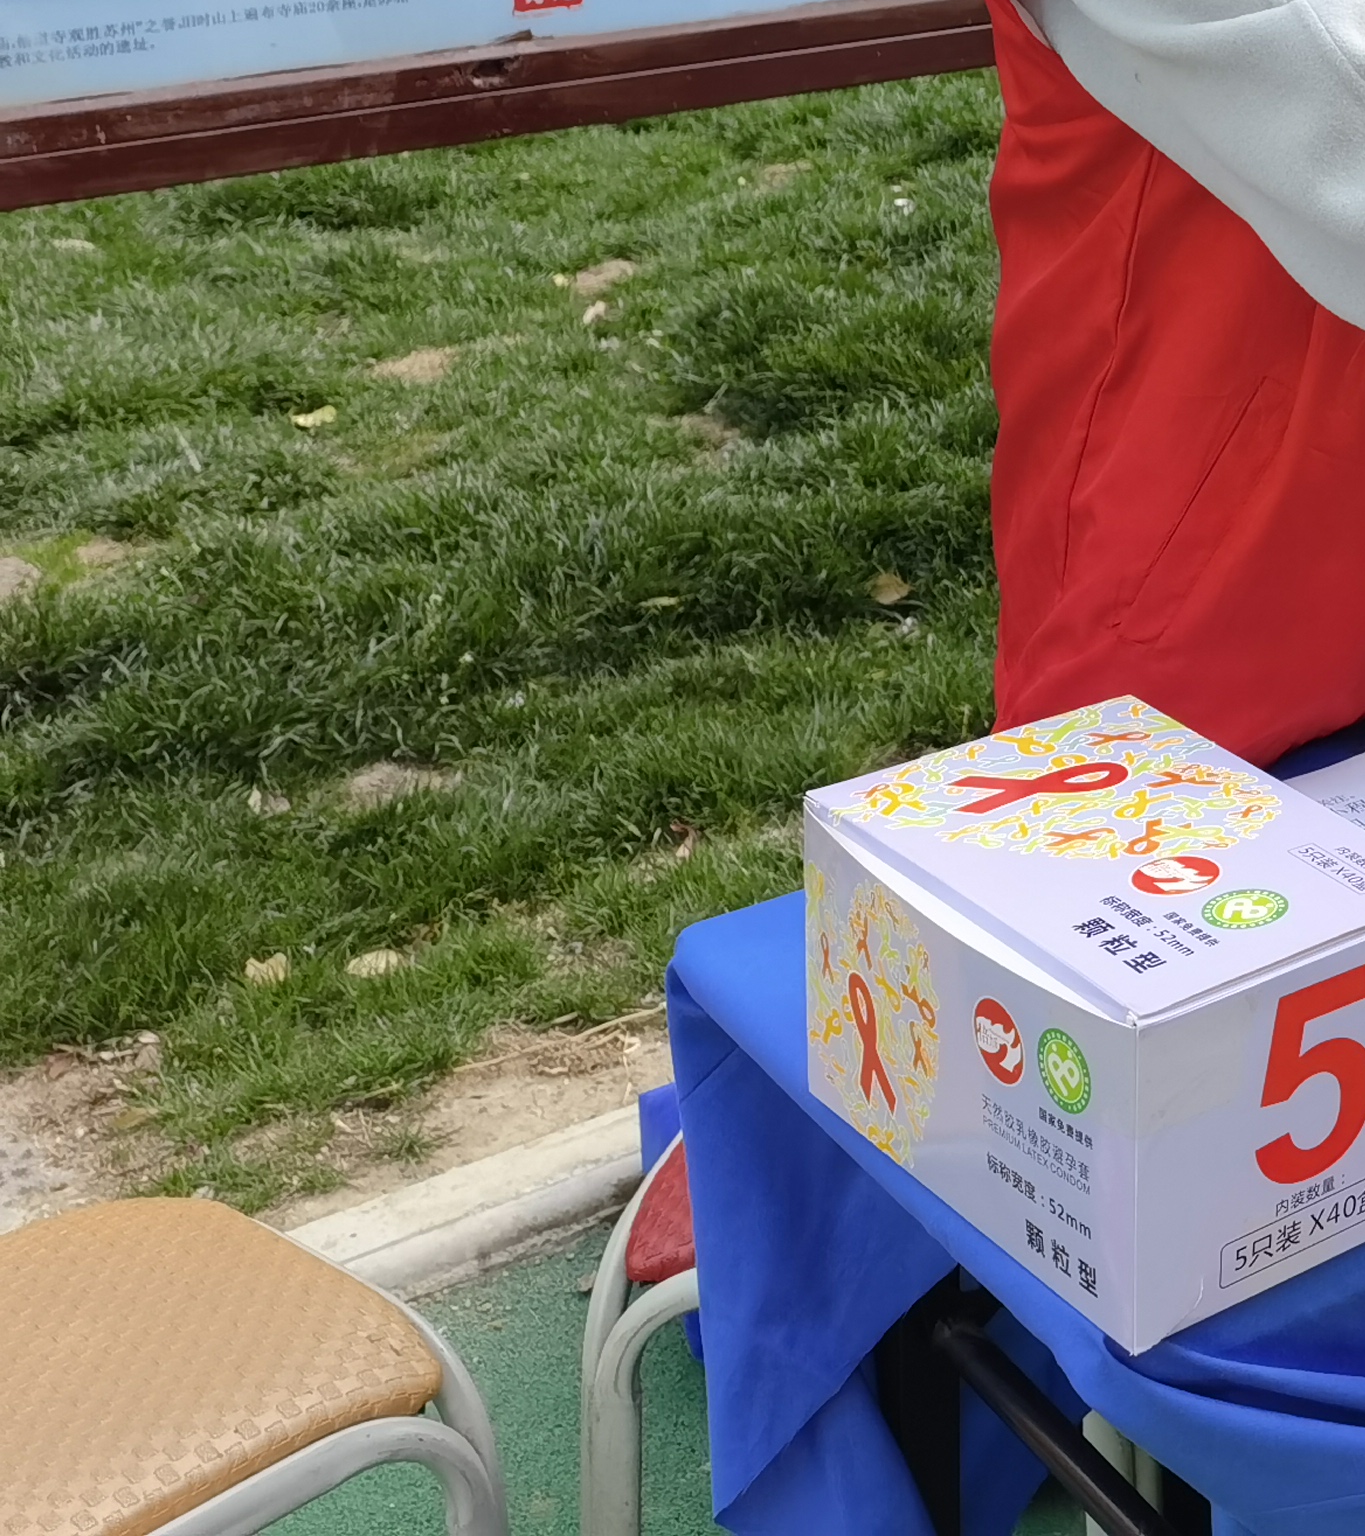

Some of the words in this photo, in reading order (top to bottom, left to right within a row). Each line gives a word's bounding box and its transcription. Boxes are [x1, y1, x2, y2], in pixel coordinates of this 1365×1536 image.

[1071, 916, 1168, 975] 颗粒型
[981, 1093, 1090, 1183] 天然胶乳橡胶避孕套
[982, 1115, 1021, 1150] PREMIUM
[1021, 1142, 1049, 1172] LATEX
[1049, 1161, 1091, 1196] CONDOM
[1038, 1106, 1094, 1150] 国家免费提供
[1024, 1217, 1099, 1299] 颗粒型
[1233, 1220, 1302, 1272] 5只装
